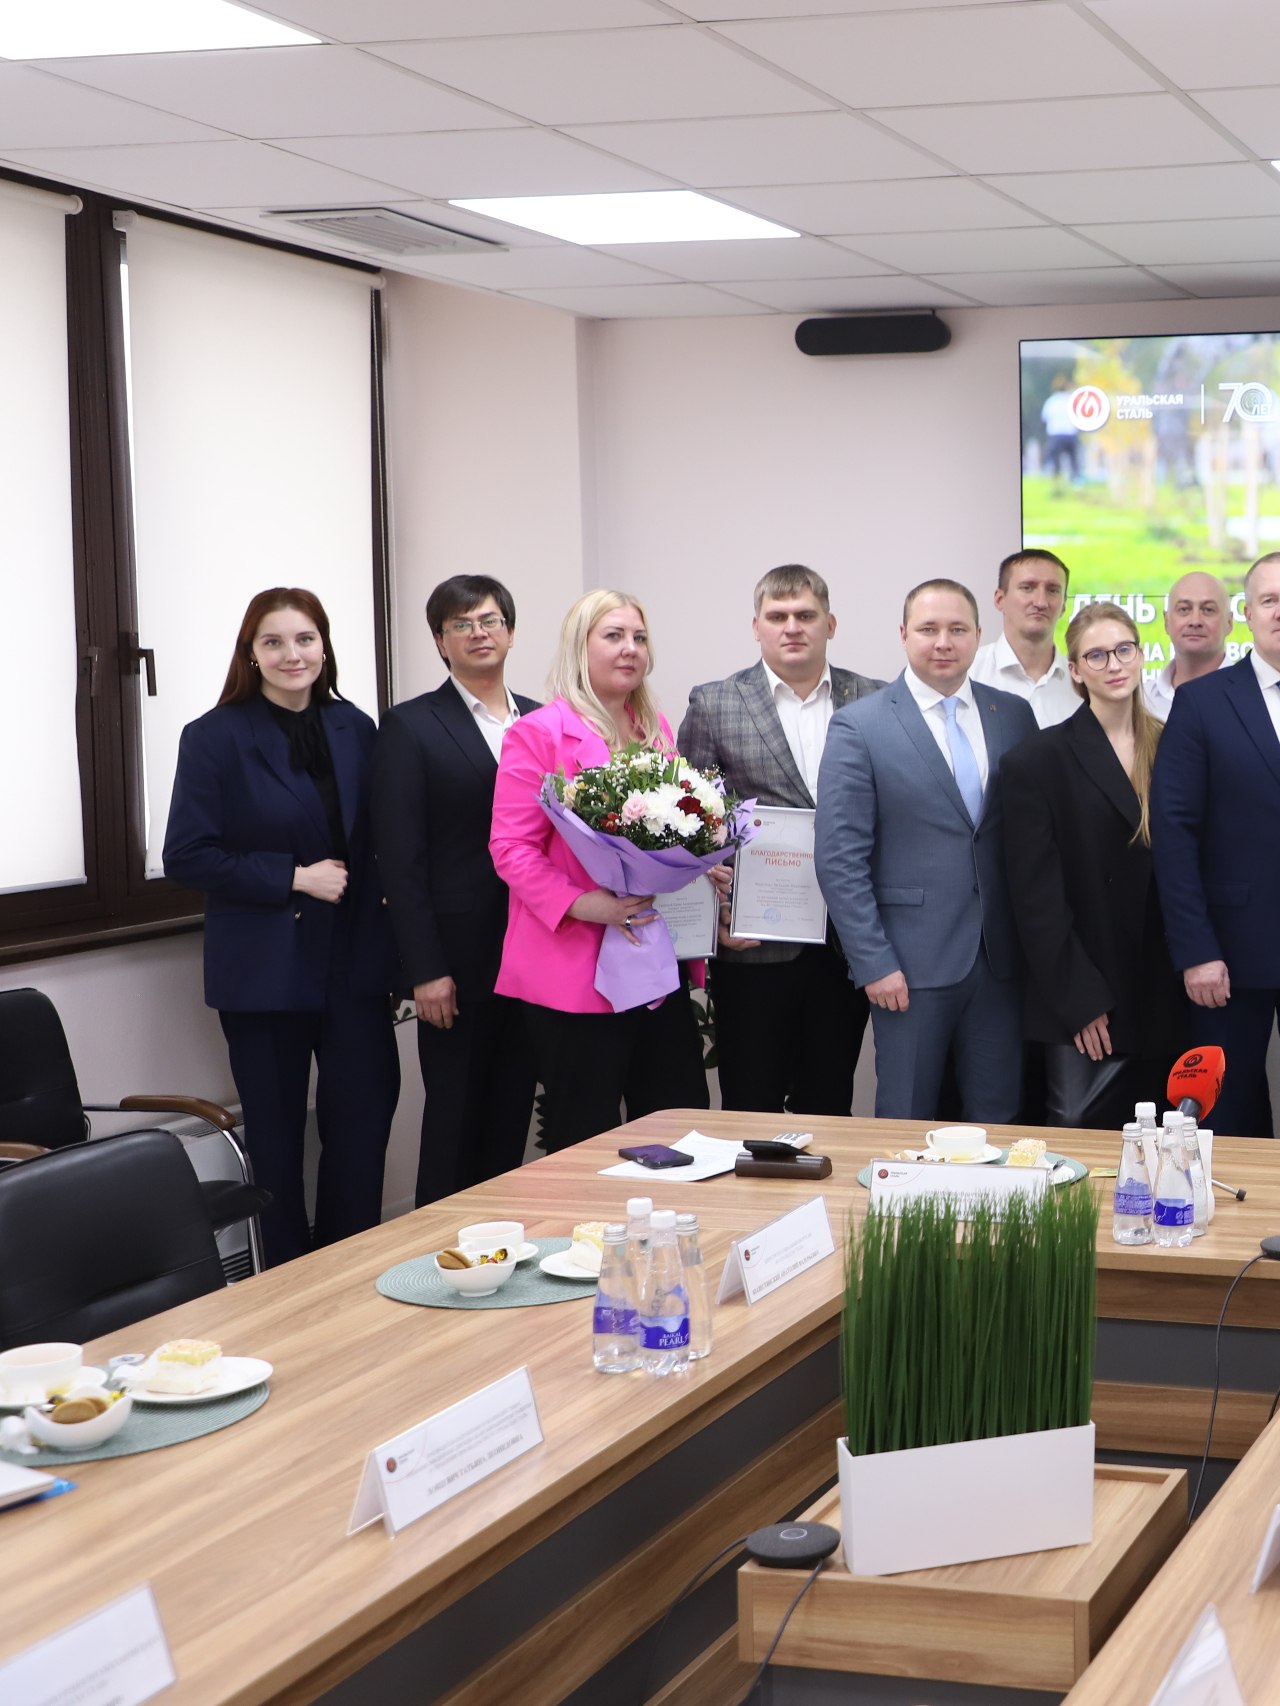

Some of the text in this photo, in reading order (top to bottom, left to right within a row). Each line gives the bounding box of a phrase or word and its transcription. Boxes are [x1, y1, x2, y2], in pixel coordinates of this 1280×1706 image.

[1116, 393, 1184, 407] УРАЛЬСКАЯ
[1219, 382, 1273, 422] 70
[1116, 408, 1153, 420] СТАЛЬ
[1251, 404, 1273, 416] ЛЕТ
[750, 849, 814, 860] БЛАГОДАРСТВЕННО
[765, 857, 801, 868] ПИСЬМО
